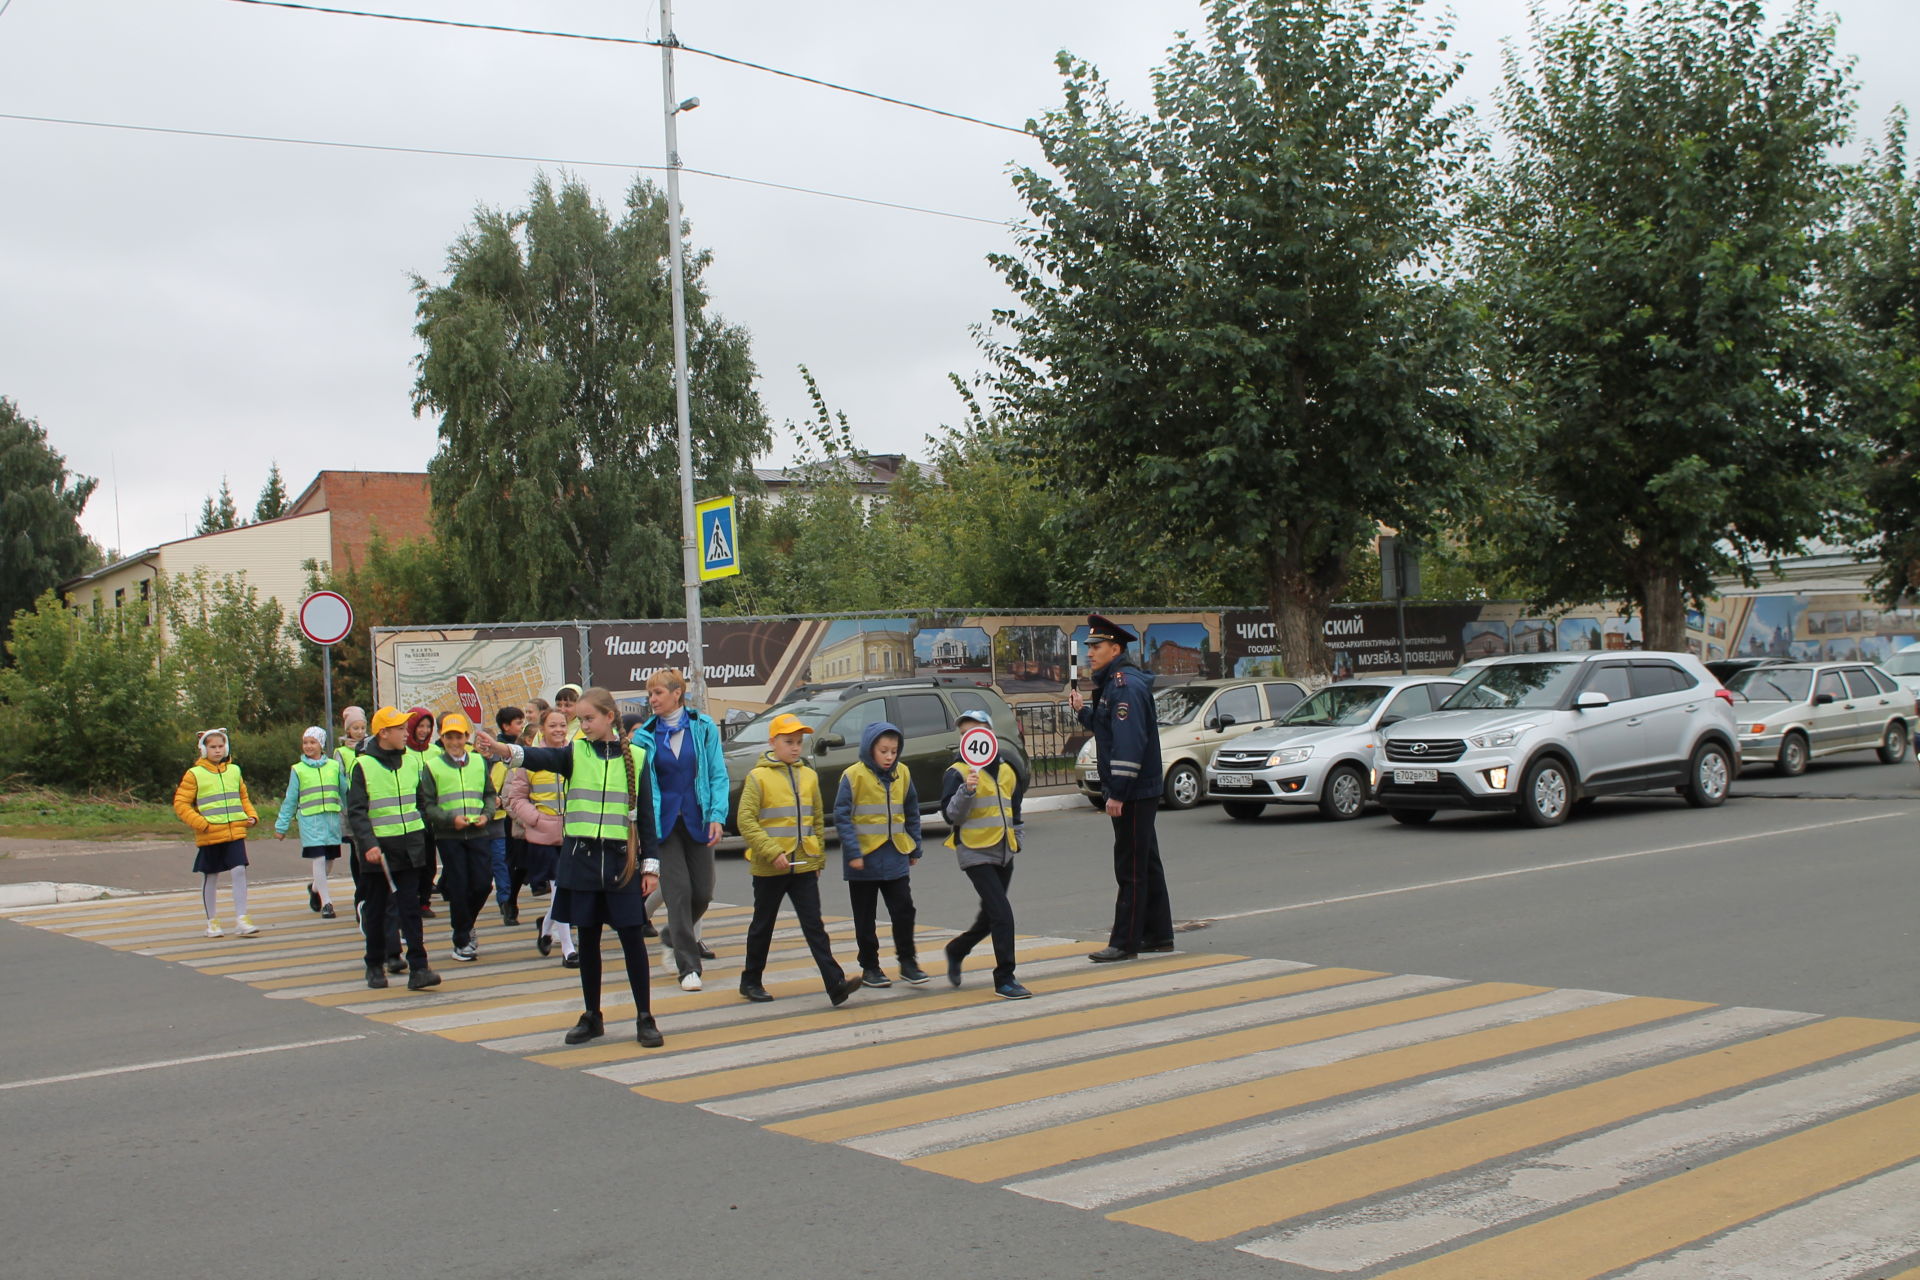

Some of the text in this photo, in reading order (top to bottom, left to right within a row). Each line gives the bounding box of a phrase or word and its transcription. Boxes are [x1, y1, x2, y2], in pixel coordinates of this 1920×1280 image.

[605, 636, 646, 655] Наш
[649, 639, 690, 659] горо
[1358, 650, 1455, 666] МУЗЕЙ-ЗПОВЕДНИК
[682, 664, 755, 683] итория
[460, 692, 477, 708] STOP
[968, 739, 990, 756] 40
